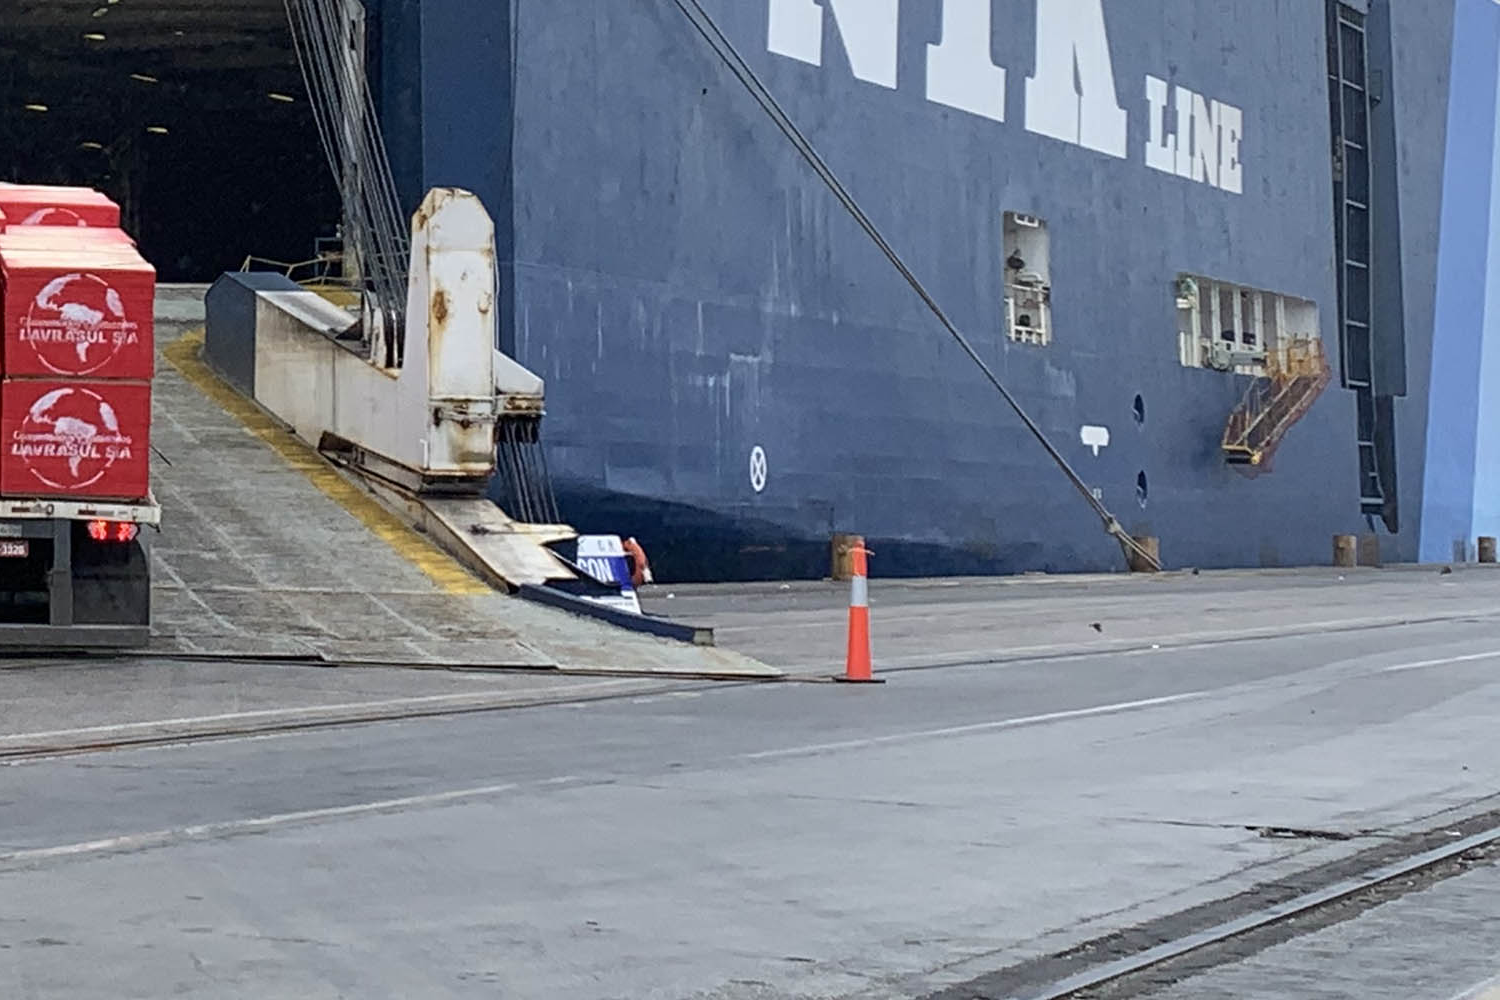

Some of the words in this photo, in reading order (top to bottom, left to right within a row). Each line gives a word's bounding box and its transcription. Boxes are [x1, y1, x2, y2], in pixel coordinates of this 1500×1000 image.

[1145, 74, 1243, 194] LINE
[19, 328, 107, 344] LAVRASUL
[11, 443, 101, 459] LAVRASUL
